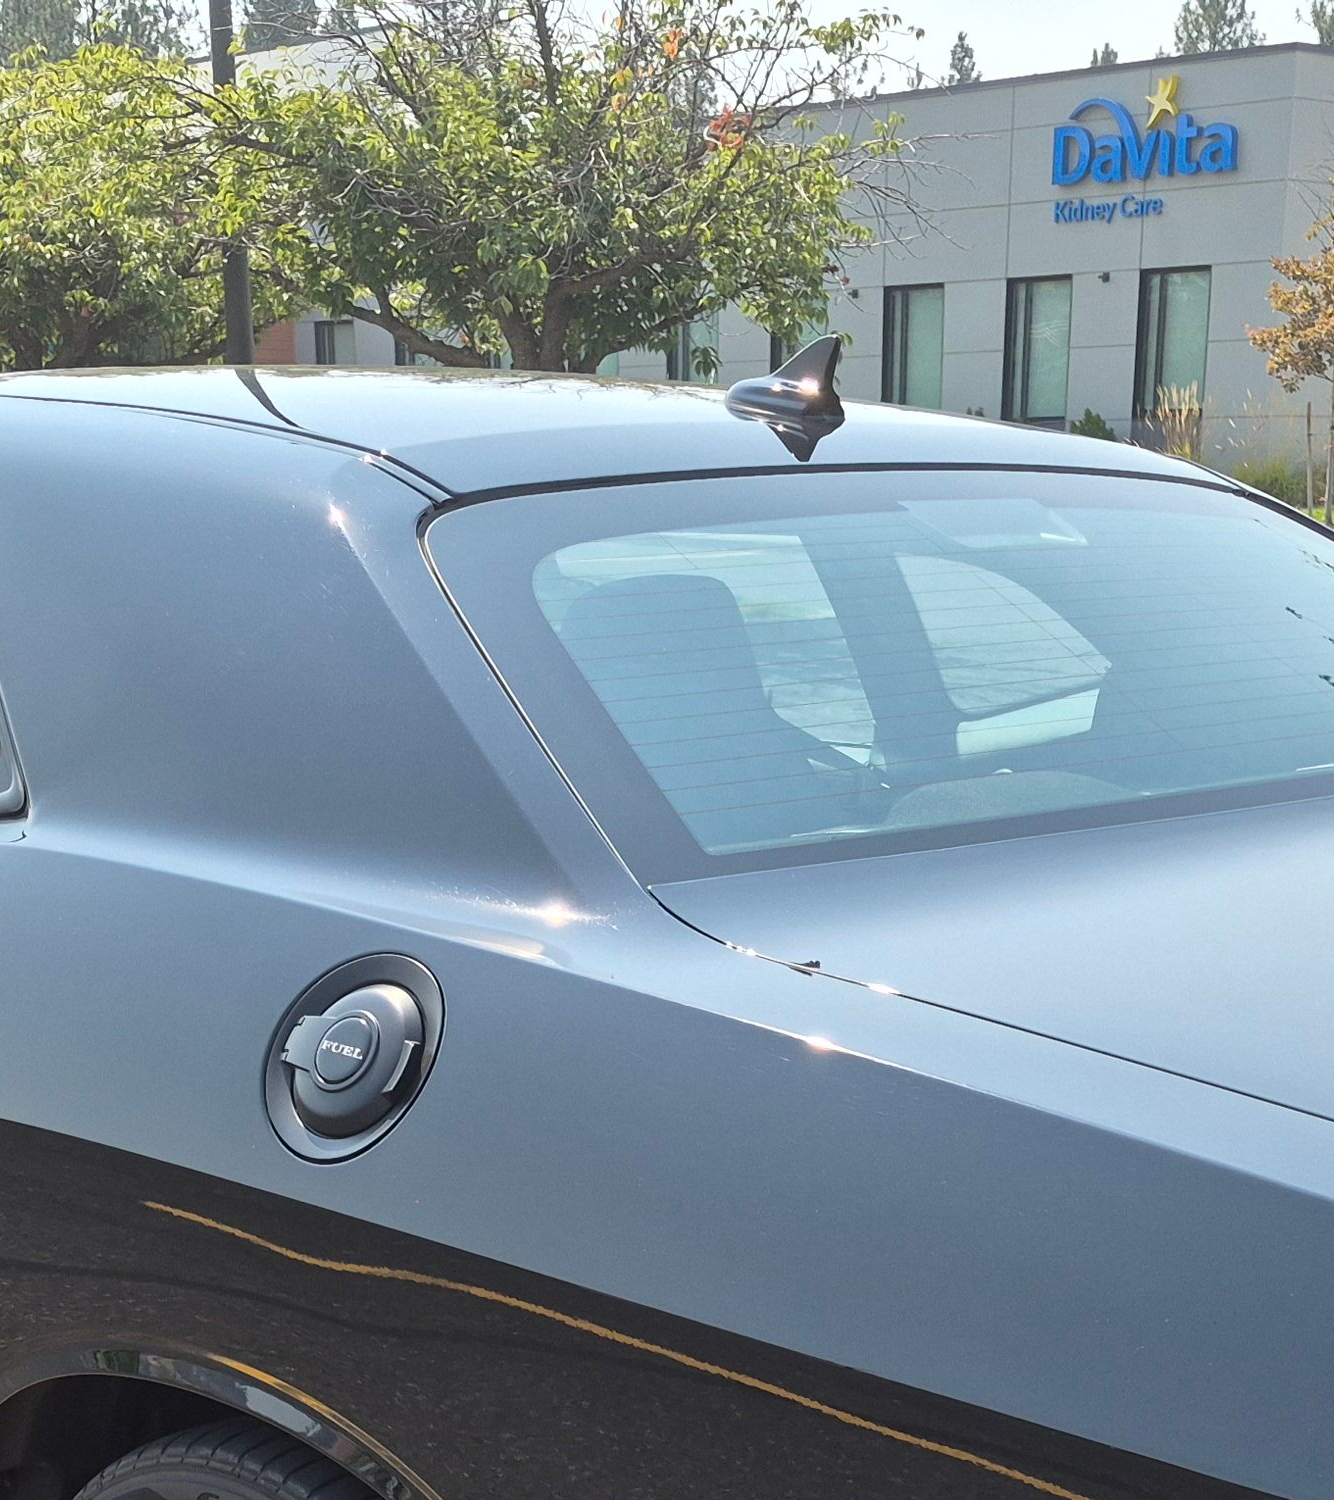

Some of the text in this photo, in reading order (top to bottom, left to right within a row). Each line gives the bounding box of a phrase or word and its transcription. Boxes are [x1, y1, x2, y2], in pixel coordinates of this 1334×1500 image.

[1051, 78, 1239, 187] DaVita
[1054, 194, 1164, 224] Kidney Care
[321, 1039, 364, 1060] FUEL
